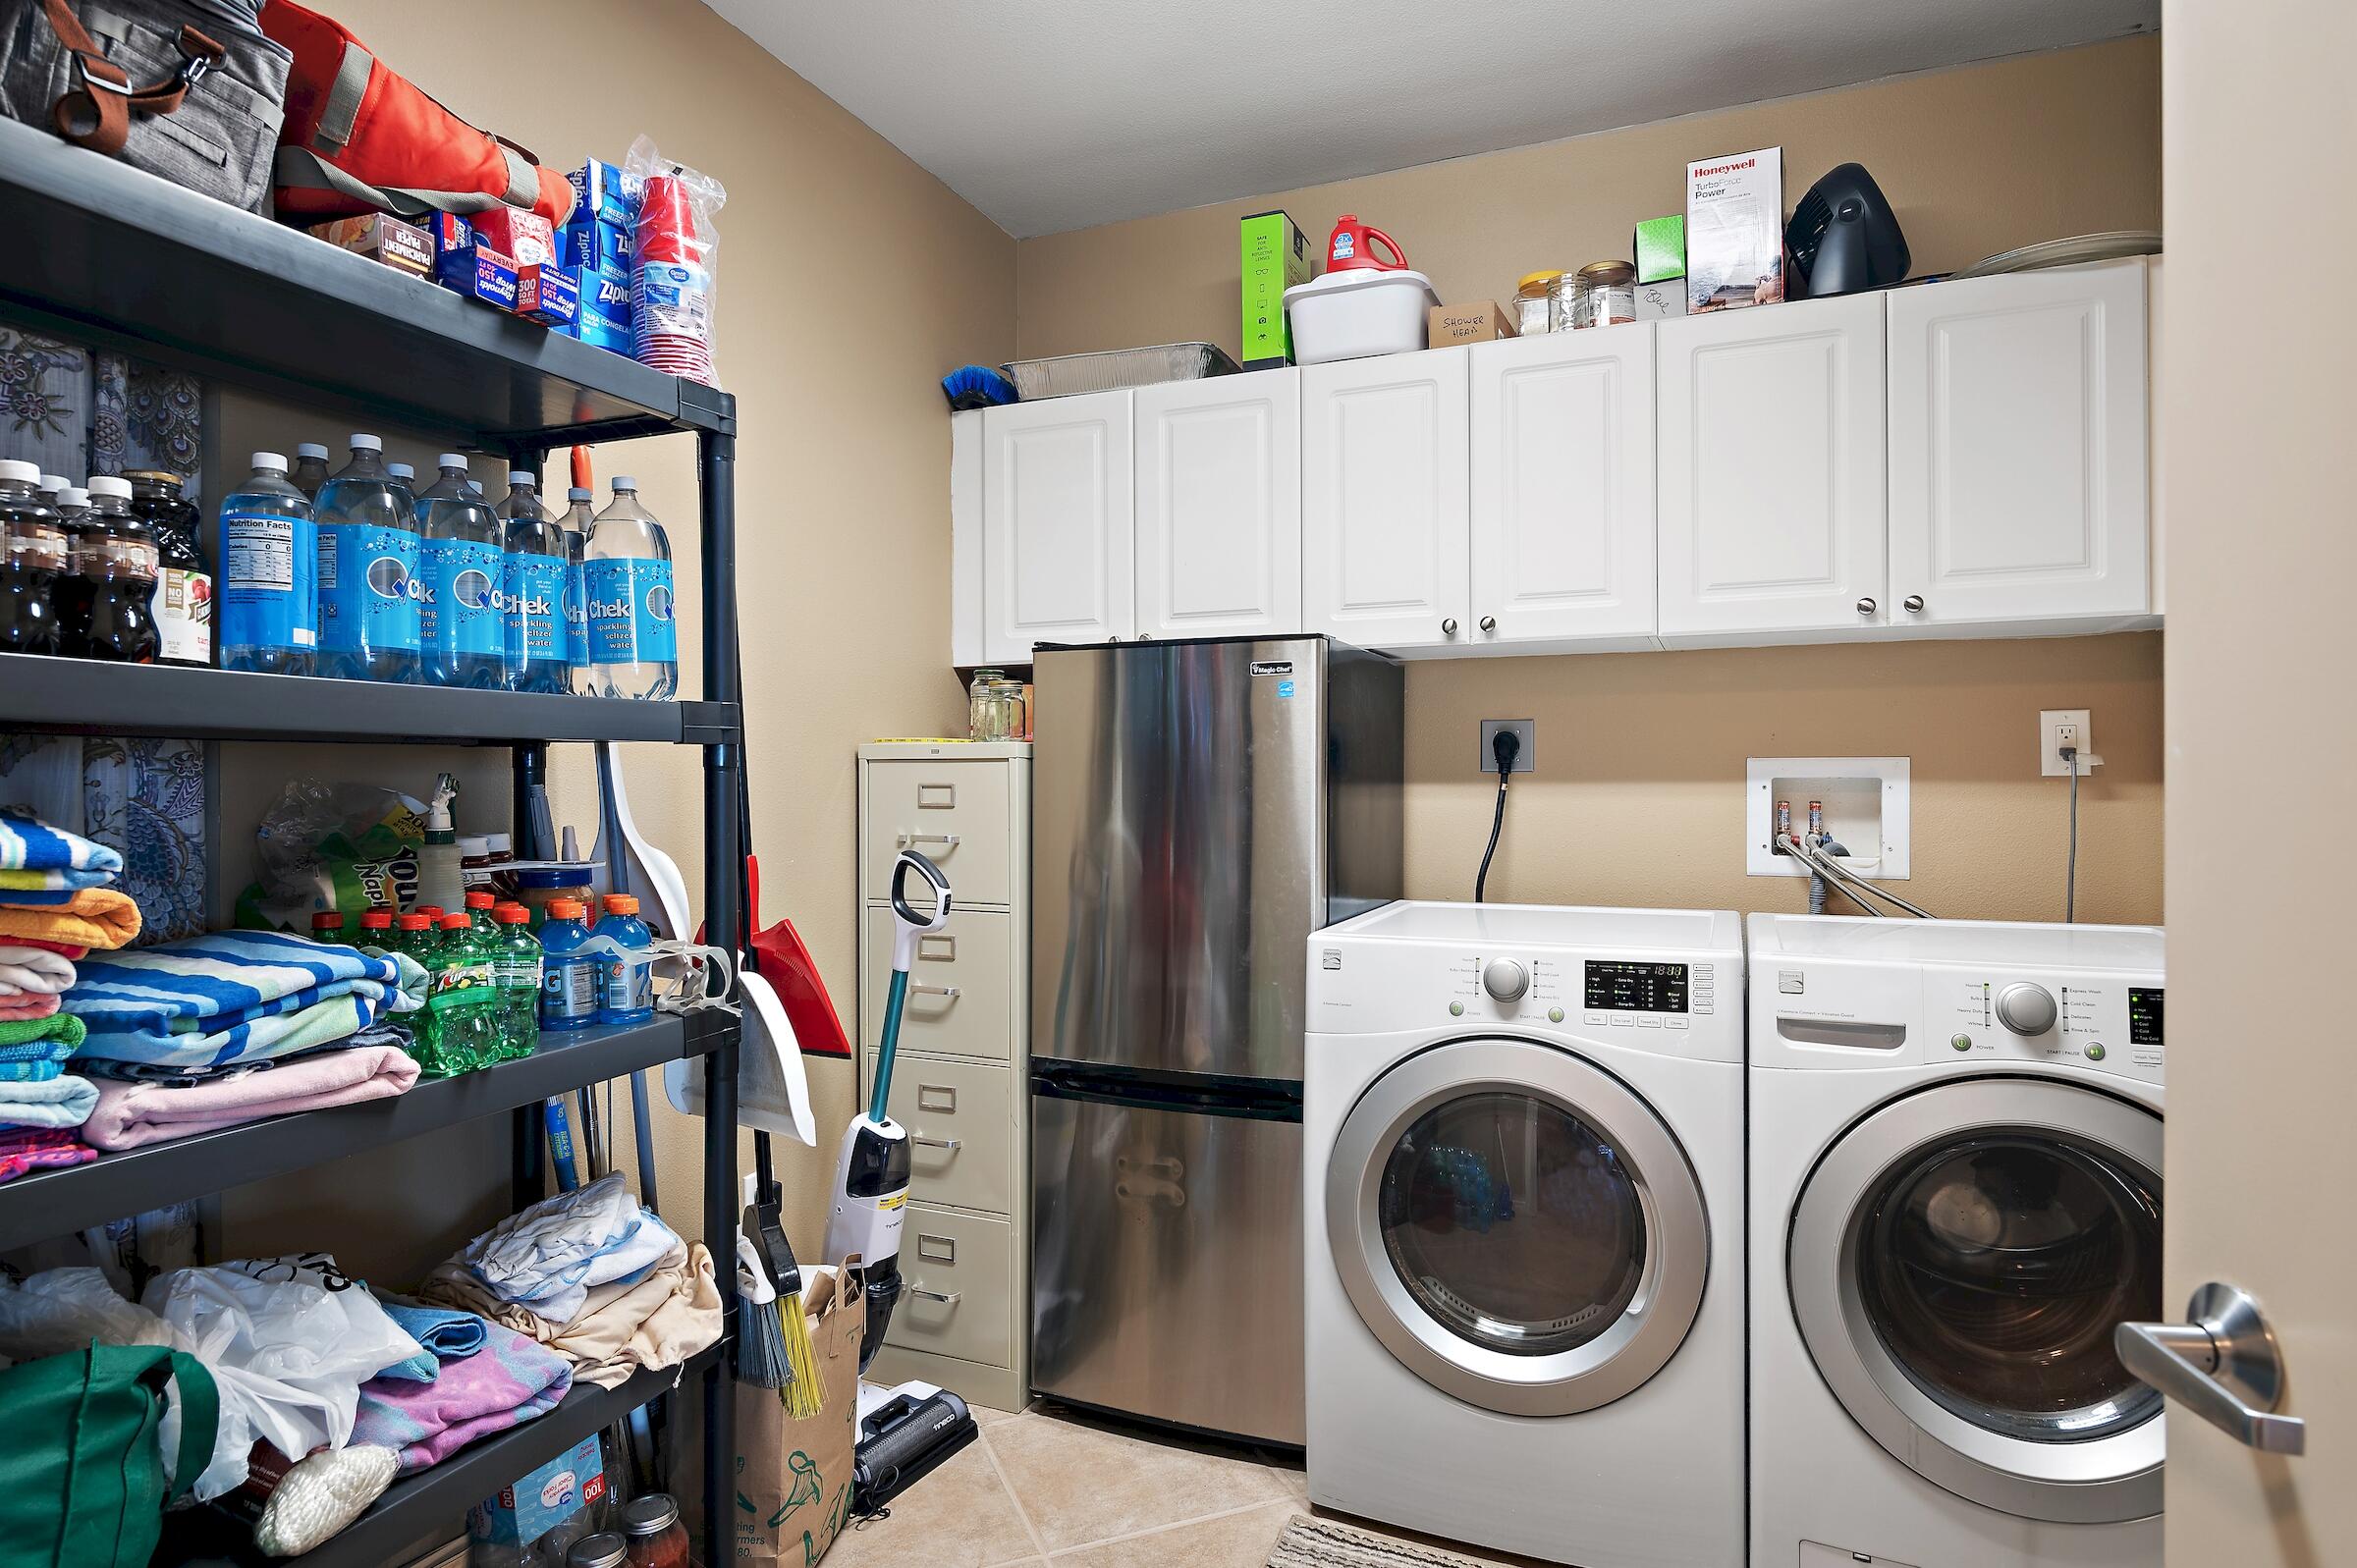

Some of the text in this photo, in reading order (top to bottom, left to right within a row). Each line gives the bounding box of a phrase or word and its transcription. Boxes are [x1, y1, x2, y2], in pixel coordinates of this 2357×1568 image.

[1694, 158, 1756, 178] Honeywell
[1695, 188, 1726, 199] Power
[603, 212, 622, 224] GALLON
[396, 230, 420, 249] PAPER
[384, 239, 431, 266] PARCHMENT
[577, 231, 591, 267] Ziploc
[480, 251, 515, 269] EVERYDAY
[479, 269, 496, 281] 150
[602, 263, 629, 280] FREEZER
[479, 281, 515, 300] Reynolds
[496, 275, 516, 294] Wrap
[519, 279, 536, 292] 300
[542, 289, 557, 299] 150
[557, 296, 576, 310] Wrap
[1643, 289, 1670, 314] Blue
[542, 298, 575, 319] Reynolds
[1443, 315, 1484, 329] SHOWER
[1453, 326, 1478, 338] HEAD
[229, 519, 292, 530] Nutrition Facts
[167, 588, 183, 598] NO
[503, 594, 551, 616] Chek
[589, 598, 631, 620] Chek
[510, 617, 553, 629] sparkling
[597, 622, 633, 631] sparkling
[544, 969, 562, 993] G
[932, 1413, 956, 1432] tineco
[584, 1481, 602, 1499] 100
